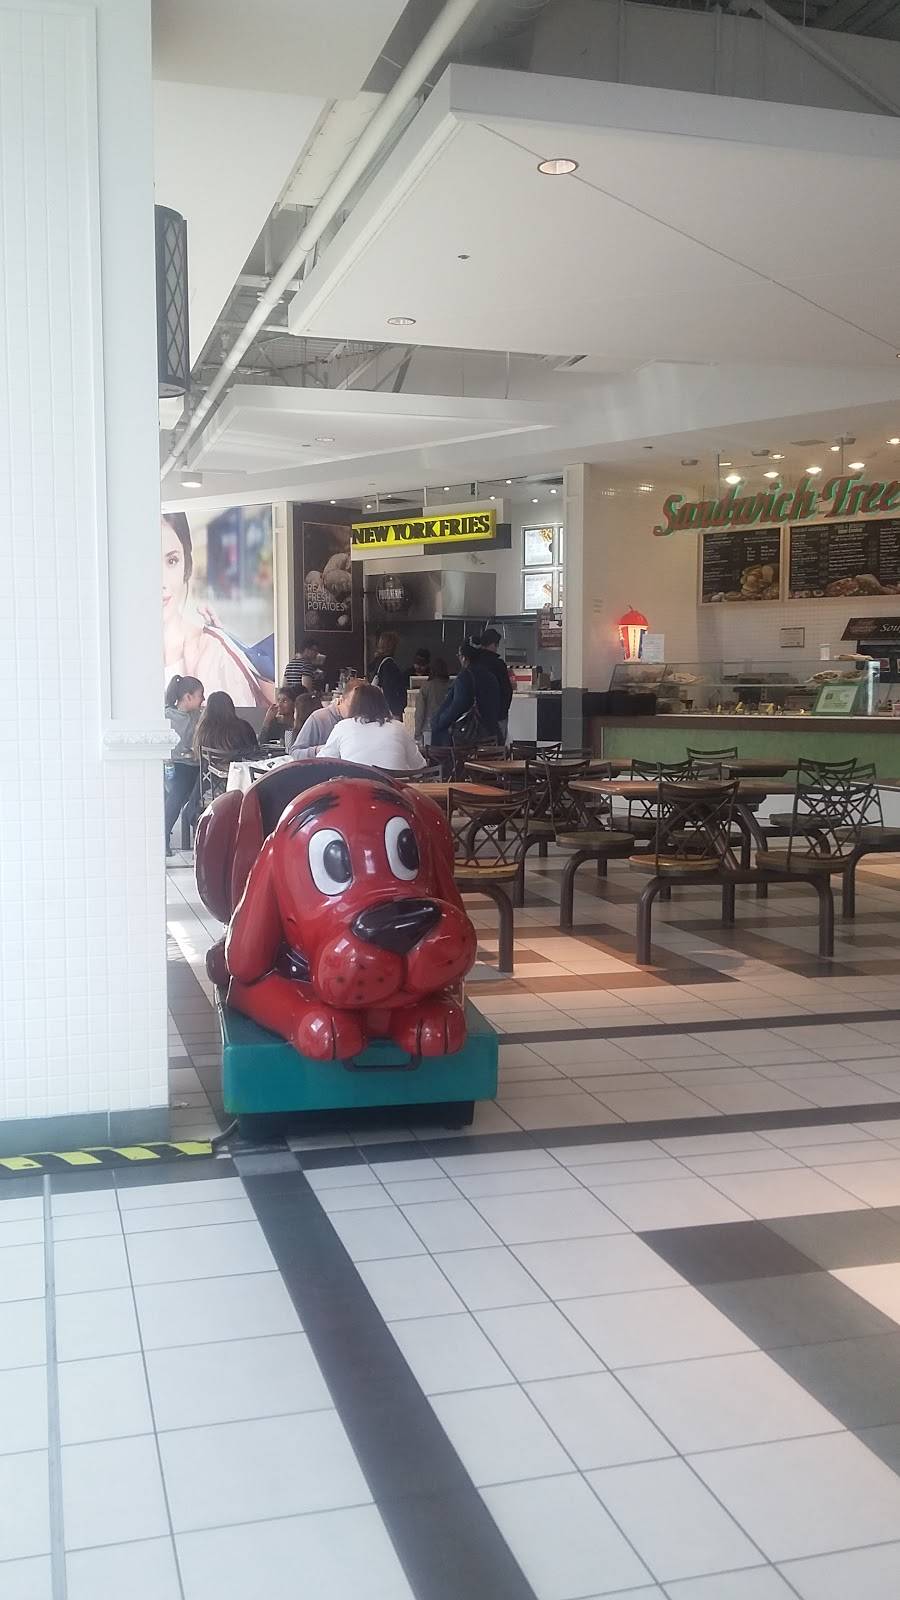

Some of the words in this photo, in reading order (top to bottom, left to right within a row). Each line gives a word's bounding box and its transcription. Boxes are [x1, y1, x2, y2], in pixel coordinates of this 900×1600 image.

[653, 476, 818, 537] Sandwich
[821, 472, 900, 518] Tree
[352, 525, 390, 544] NEW
[390, 520, 439, 541] YORK
[439, 515, 490, 537] FRIES
[307, 583, 326, 593] REAL
[307, 592, 332, 602] FRESH
[307, 601, 345, 612] POTATOES
